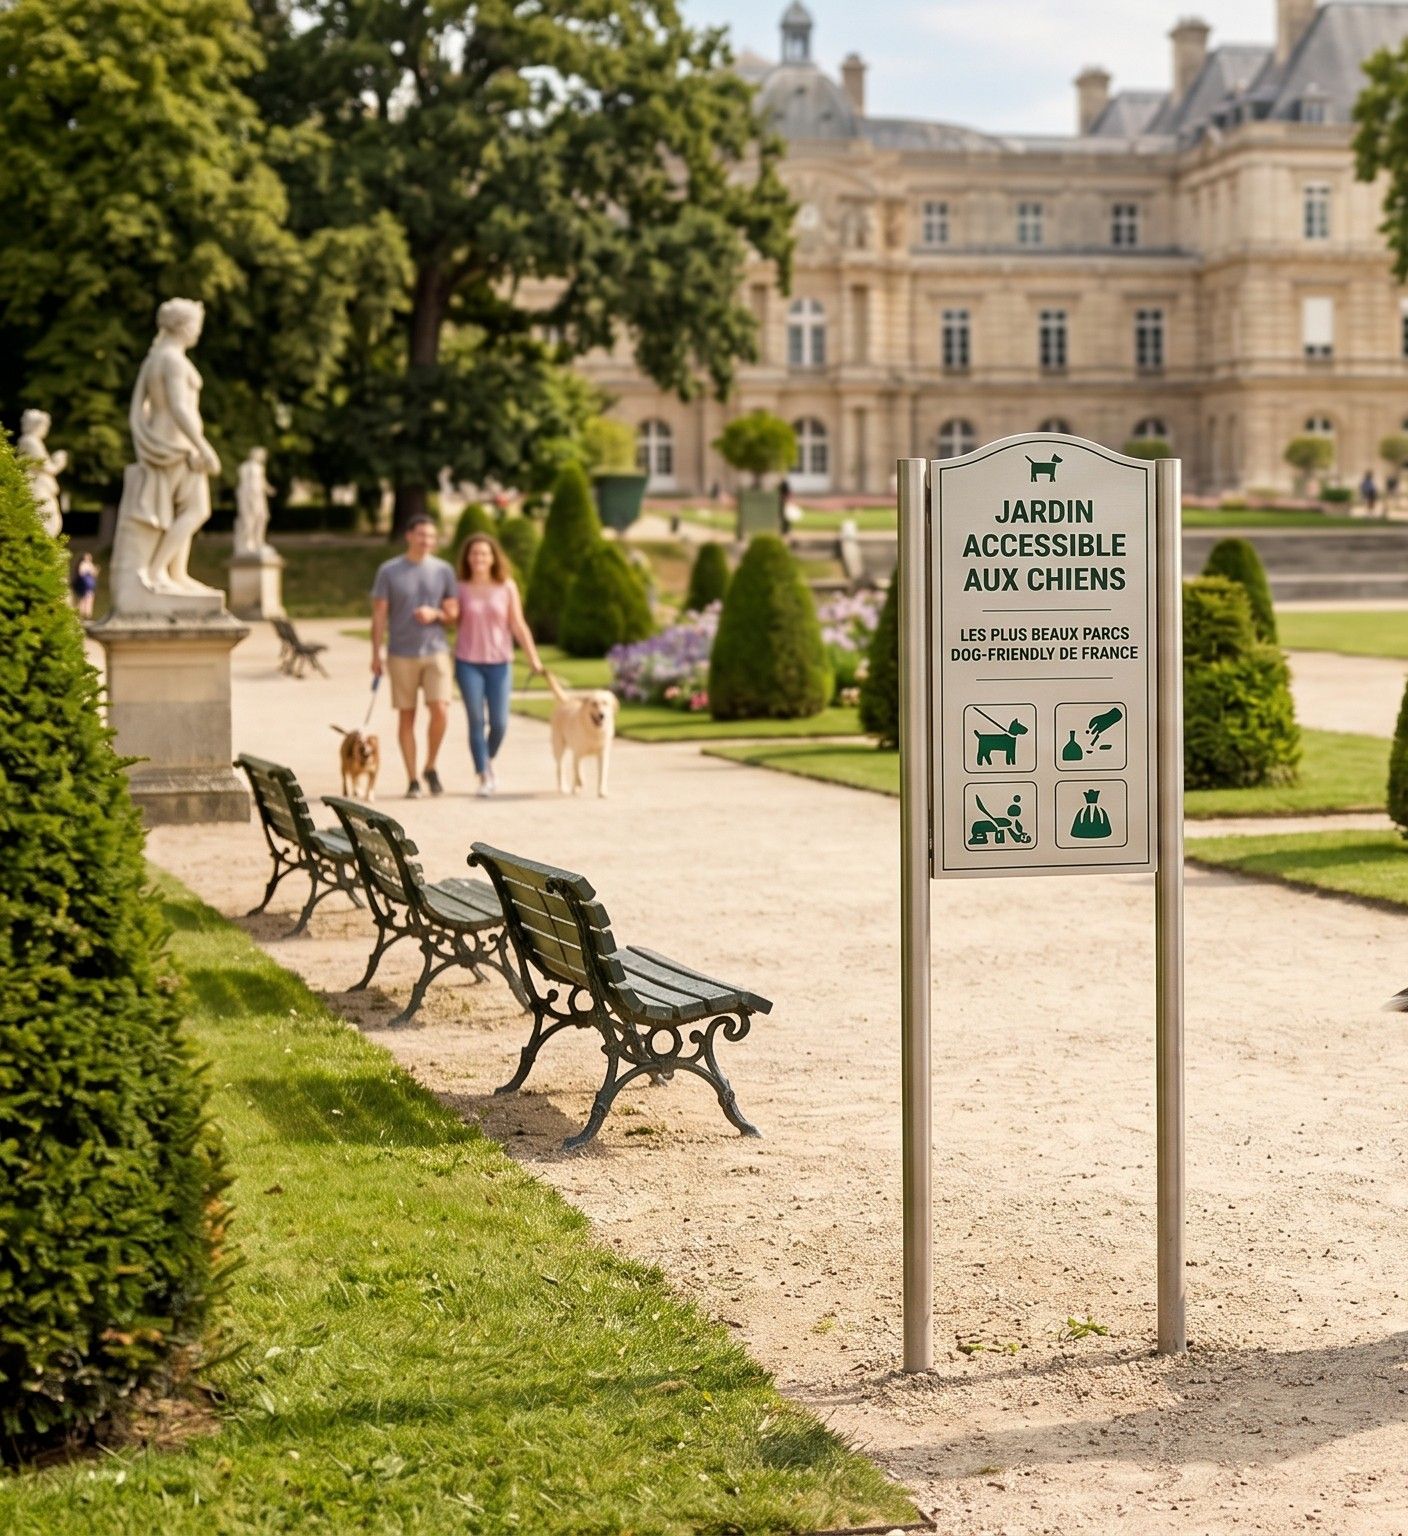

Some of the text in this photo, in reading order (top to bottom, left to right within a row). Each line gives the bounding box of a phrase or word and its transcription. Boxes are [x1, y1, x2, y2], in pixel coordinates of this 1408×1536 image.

[995, 500, 1092, 523] JARDIN
[963, 534, 1126, 557] ACCESSIBLE
[964, 567, 1125, 591] AUX CHIENS
[961, 627, 1129, 641] LES PLUS BEAUX PARCS
[952, 646, 1138, 661] DOG-FRIENDLY DE FRANCE
